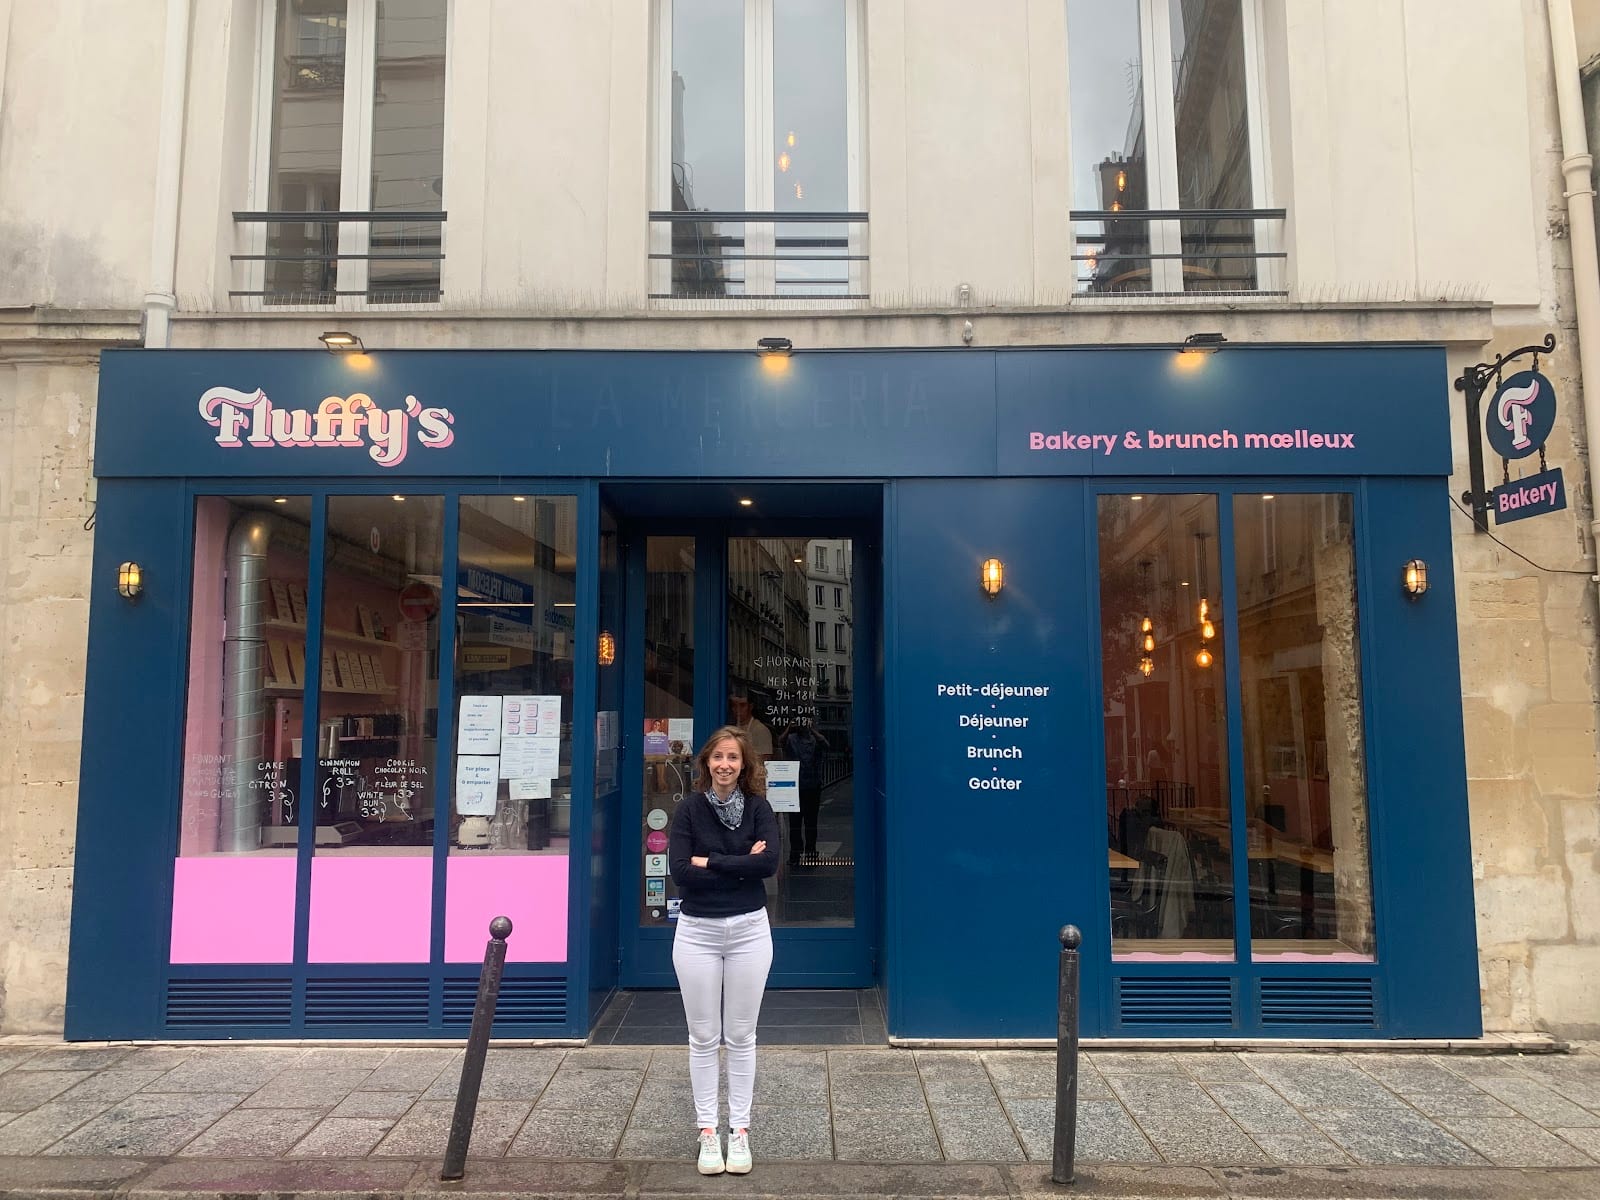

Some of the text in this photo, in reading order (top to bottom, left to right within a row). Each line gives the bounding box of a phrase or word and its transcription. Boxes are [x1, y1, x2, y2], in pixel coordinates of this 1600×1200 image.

[1498, 379, 1540, 450] F
[198, 386, 455, 467] Fluffy's
[1029, 429, 1355, 455] Bakery & brunch mœlleux
[1499, 481, 1557, 512] Bakery
[937, 683, 1049, 700] Petit-déjeuner
[959, 714, 1029, 730] Déjeuner
[967, 746, 1022, 758] Brunch
[258, 762, 284, 770] CAKE
[332, 767, 354, 776] ROLL
[264, 772, 277, 780] AU
[968, 777, 1022, 790] Goûter
